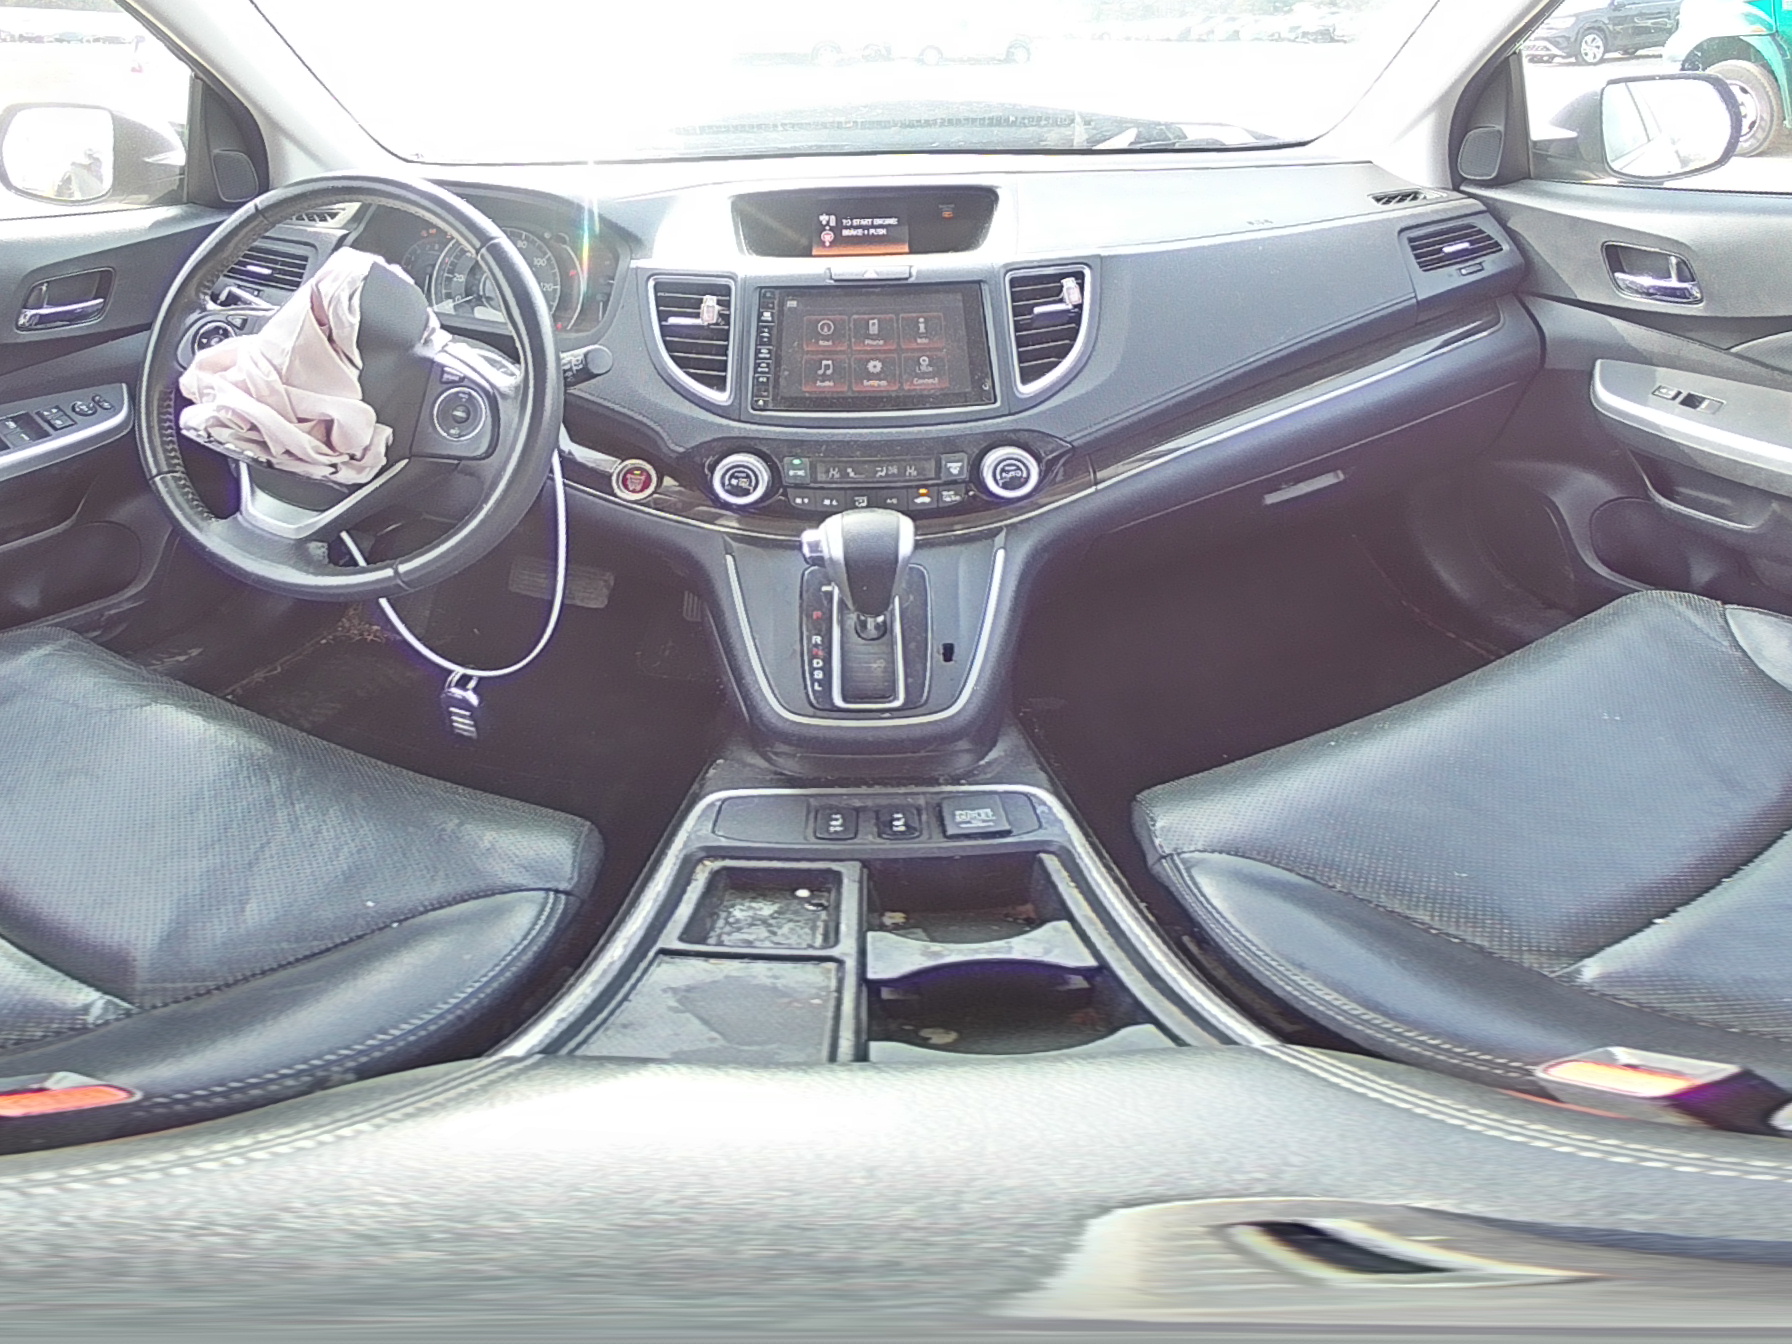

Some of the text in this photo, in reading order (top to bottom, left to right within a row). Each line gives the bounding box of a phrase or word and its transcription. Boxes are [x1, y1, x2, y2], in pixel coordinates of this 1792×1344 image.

[852, 218, 873, 226] START
[533, 258, 548, 267] 100
[453, 273, 464, 282] 20
[540, 282, 553, 291] 120
